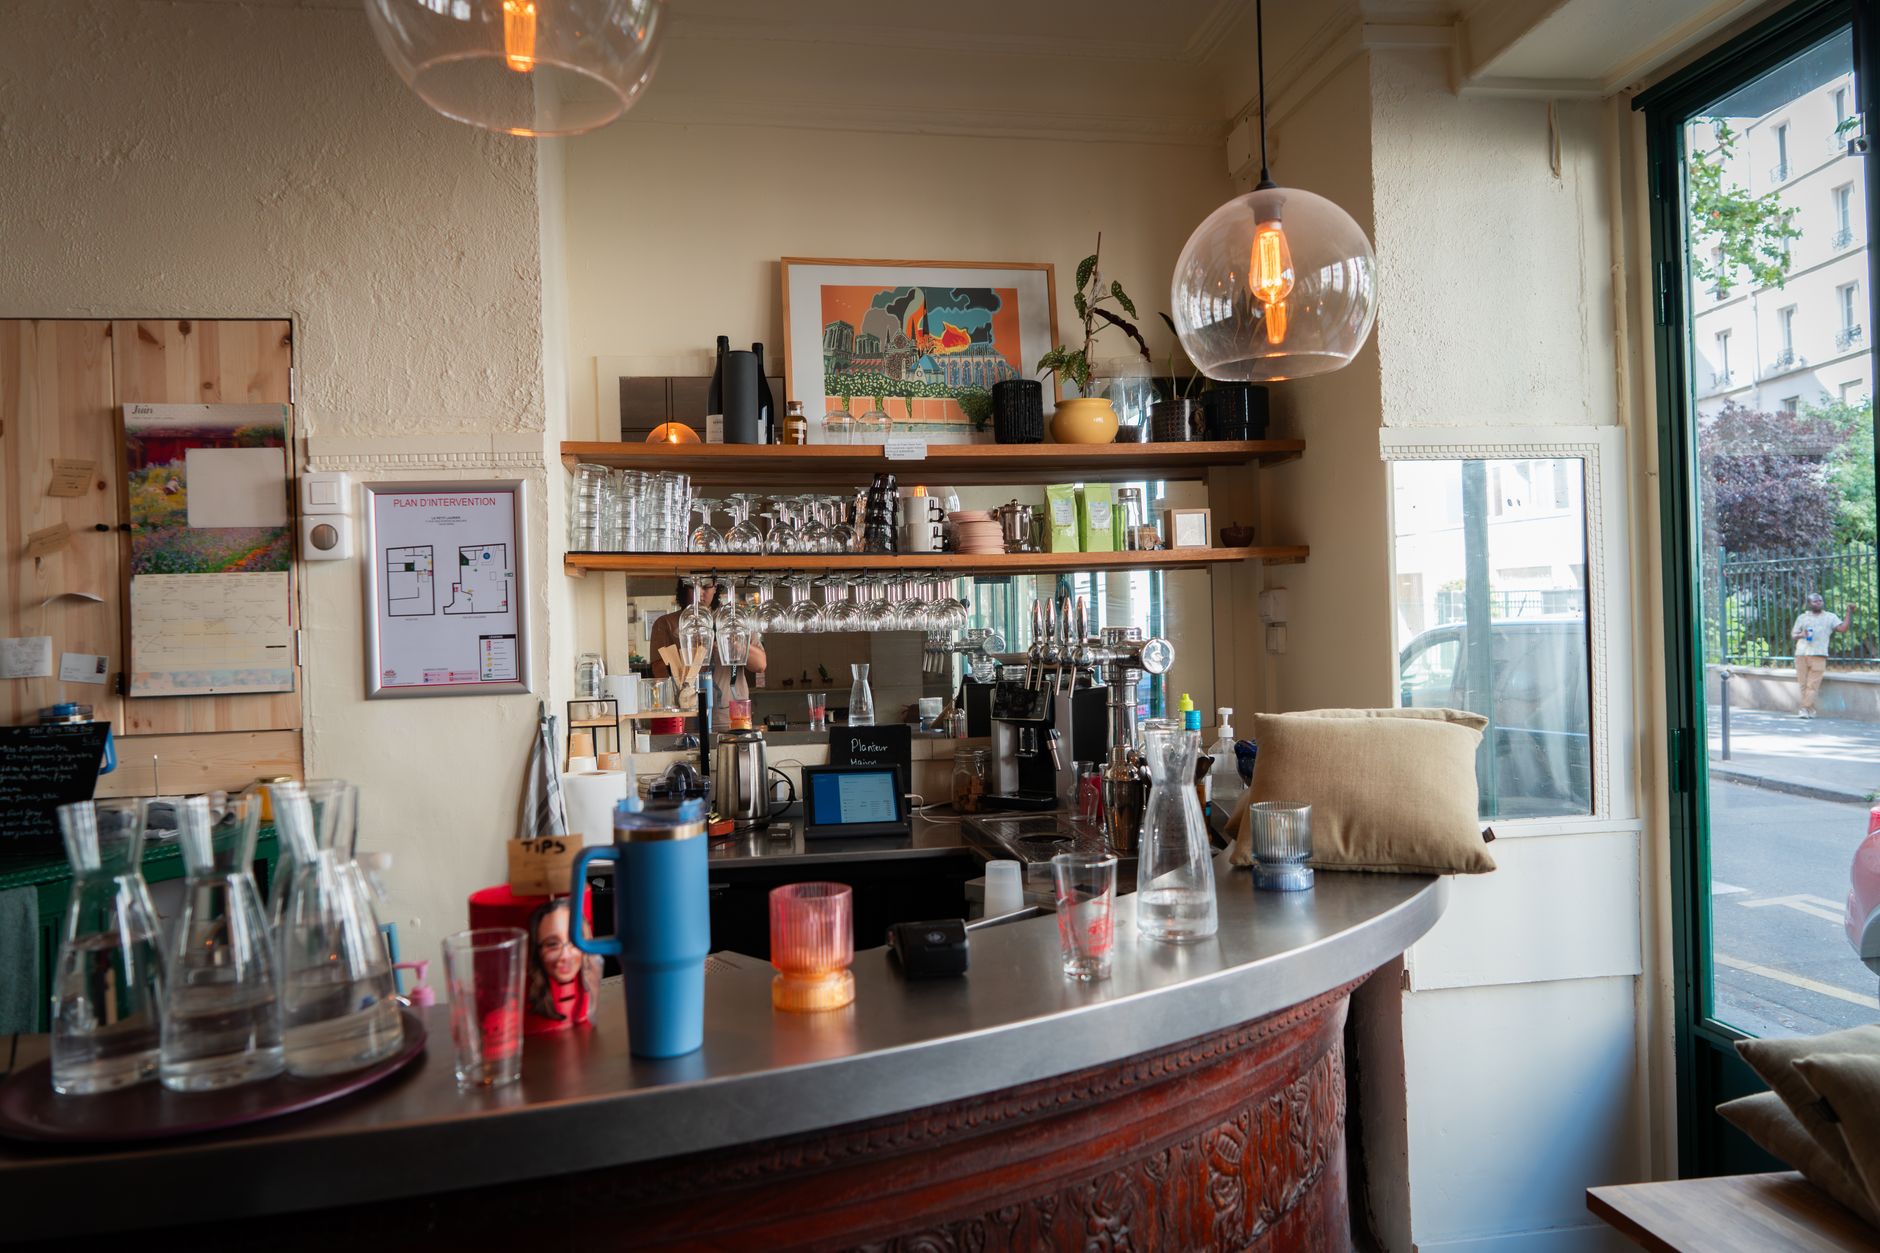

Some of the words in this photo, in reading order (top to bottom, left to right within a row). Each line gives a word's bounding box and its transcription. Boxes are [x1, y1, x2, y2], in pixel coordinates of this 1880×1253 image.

[131, 404, 153, 414] Juin
[393, 498, 418, 508] PLAN
[420, 497, 496, 507] D'INTERVENTION
[850, 737, 889, 753] Planteur
